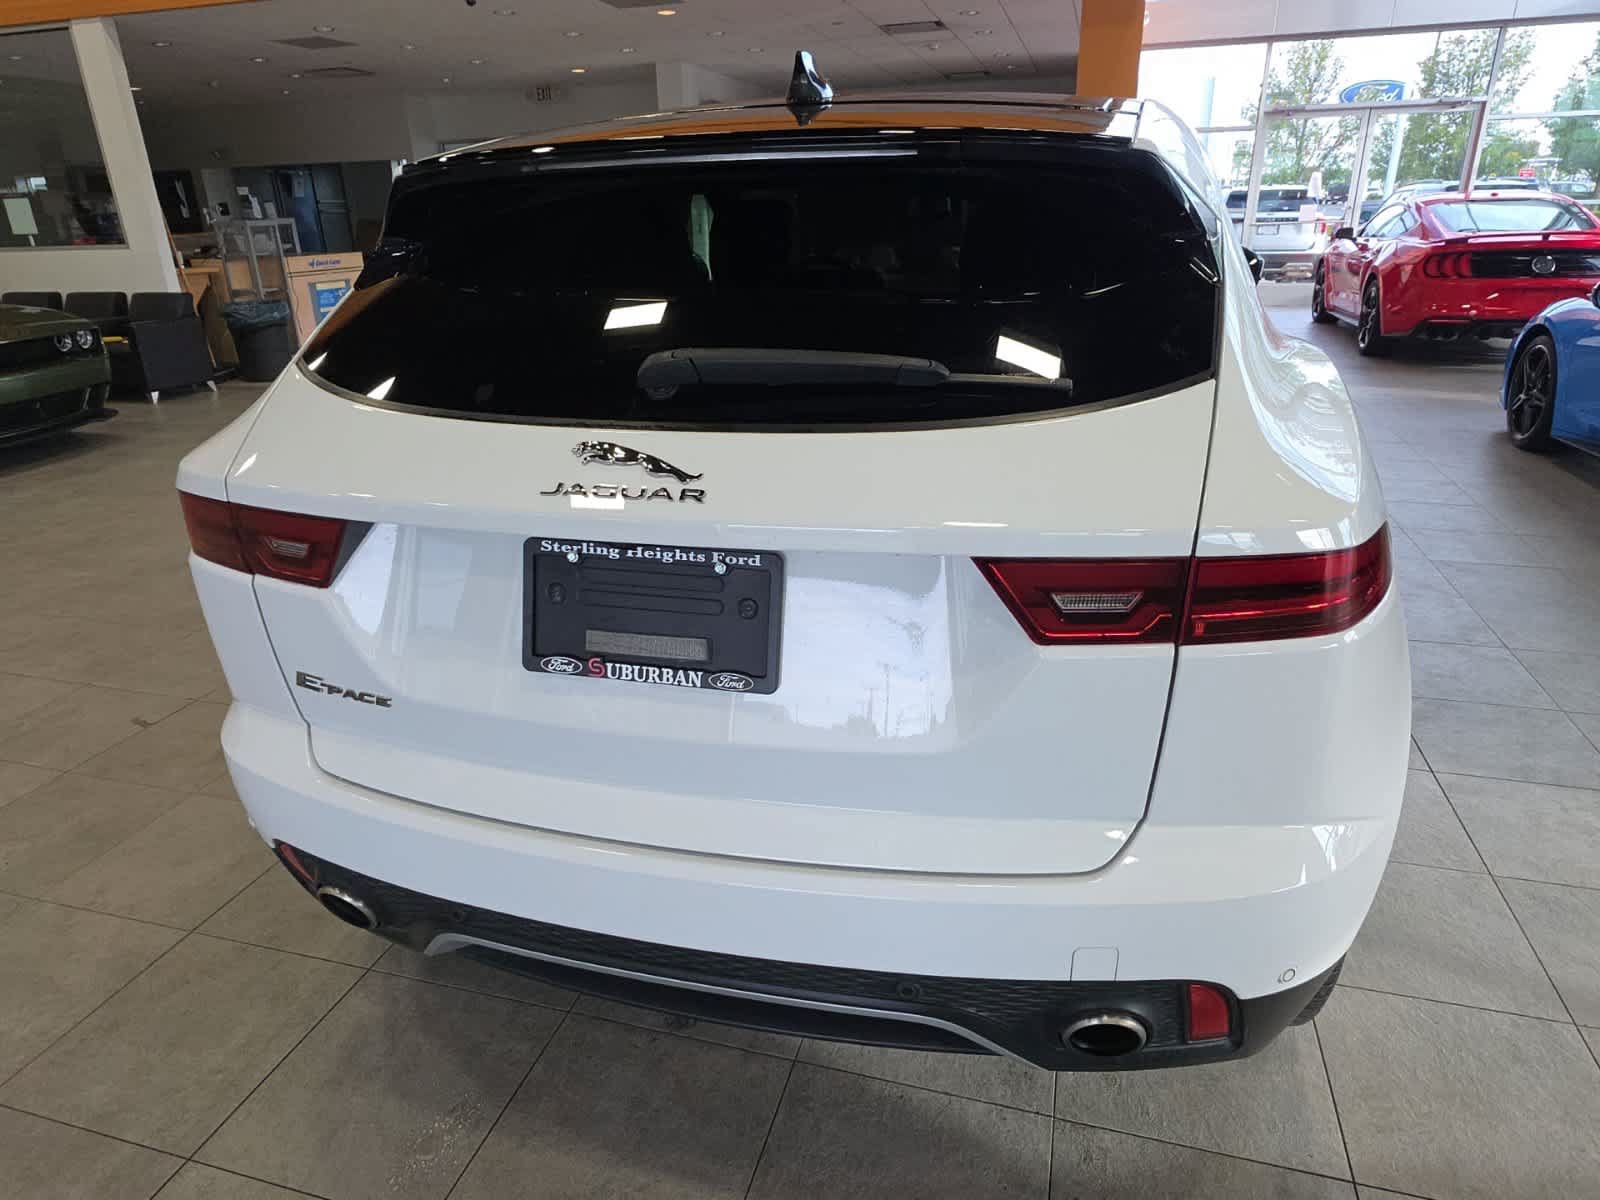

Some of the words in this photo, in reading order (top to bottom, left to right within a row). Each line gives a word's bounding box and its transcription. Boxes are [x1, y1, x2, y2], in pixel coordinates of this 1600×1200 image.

[540, 482, 707, 503] JAGUAR
[540, 540, 620, 559] Sterling
[626, 546, 706, 563] Heights
[711, 552, 762, 567] Ford
[547, 659, 575, 672] Ford
[588, 657, 704, 688] SUBURBAN
[716, 675, 746, 689] Ford
